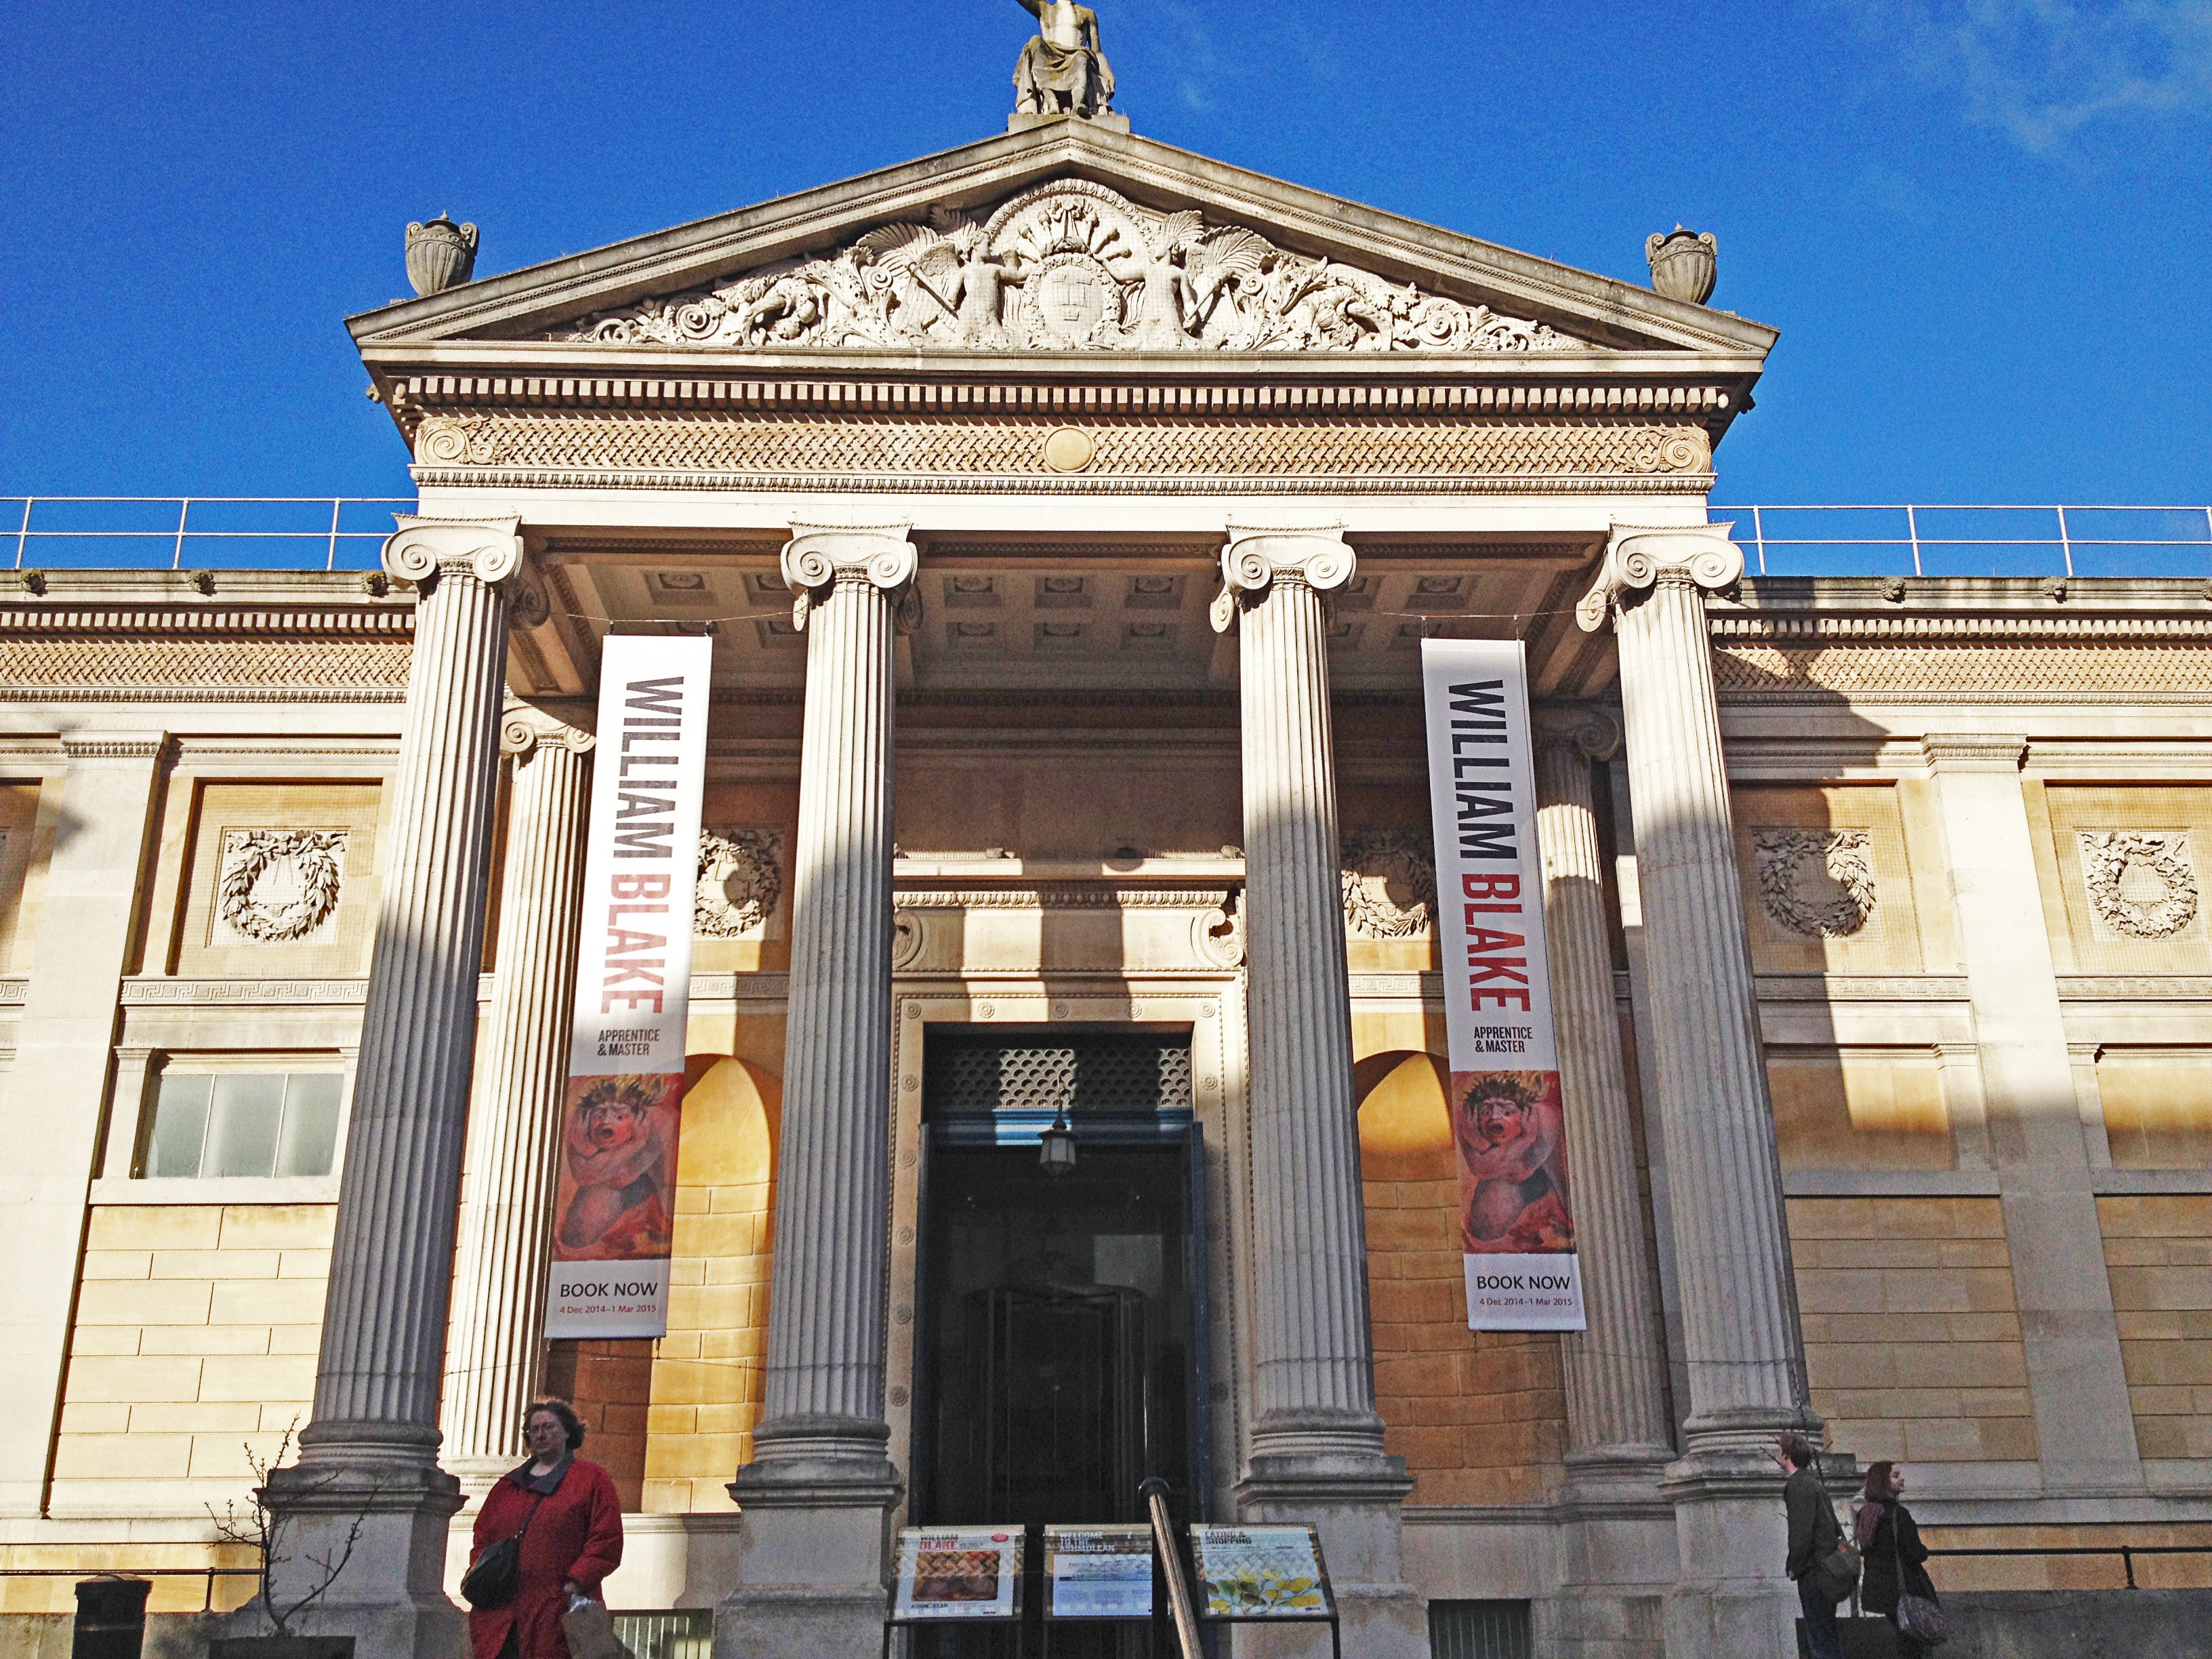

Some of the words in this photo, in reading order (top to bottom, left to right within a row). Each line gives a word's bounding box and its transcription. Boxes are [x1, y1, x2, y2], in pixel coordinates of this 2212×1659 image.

[613, 676, 684, 859] WILLIAM
[1448, 679, 1518, 859] WILLIAM
[600, 874, 672, 1014] BLAKE
[1461, 873, 1532, 1012] BLAKE
[598, 1028, 661, 1042] APPRENTICE
[1473, 1026, 1533, 1040] APPRENTICE
[597, 1044, 607, 1057] &
[608, 1042, 651, 1056] MASTER
[1475, 1040, 1485, 1052] &
[1485, 1040, 1525, 1052] MASTER
[1477, 1275, 1524, 1290] BOOK
[1528, 1275, 1570, 1290] NOW
[560, 1282, 609, 1298] BOOK
[613, 1282, 658, 1297] NOW
[1479, 1298, 1485, 1306] 4
[1486, 1298, 1502, 1306] Dec
[1536, 1298, 1551, 1306] Mar
[1553, 1297, 1572, 1306] 2015
[559, 1306, 565, 1314] 4
[567, 1305, 583, 1314] Dec
[618, 1305, 634, 1313] Mar
[636, 1304, 657, 1313] 2015
[919, 1540, 958, 1550] BLAKE
[1206, 1536, 1252, 1544] SHOPPING
